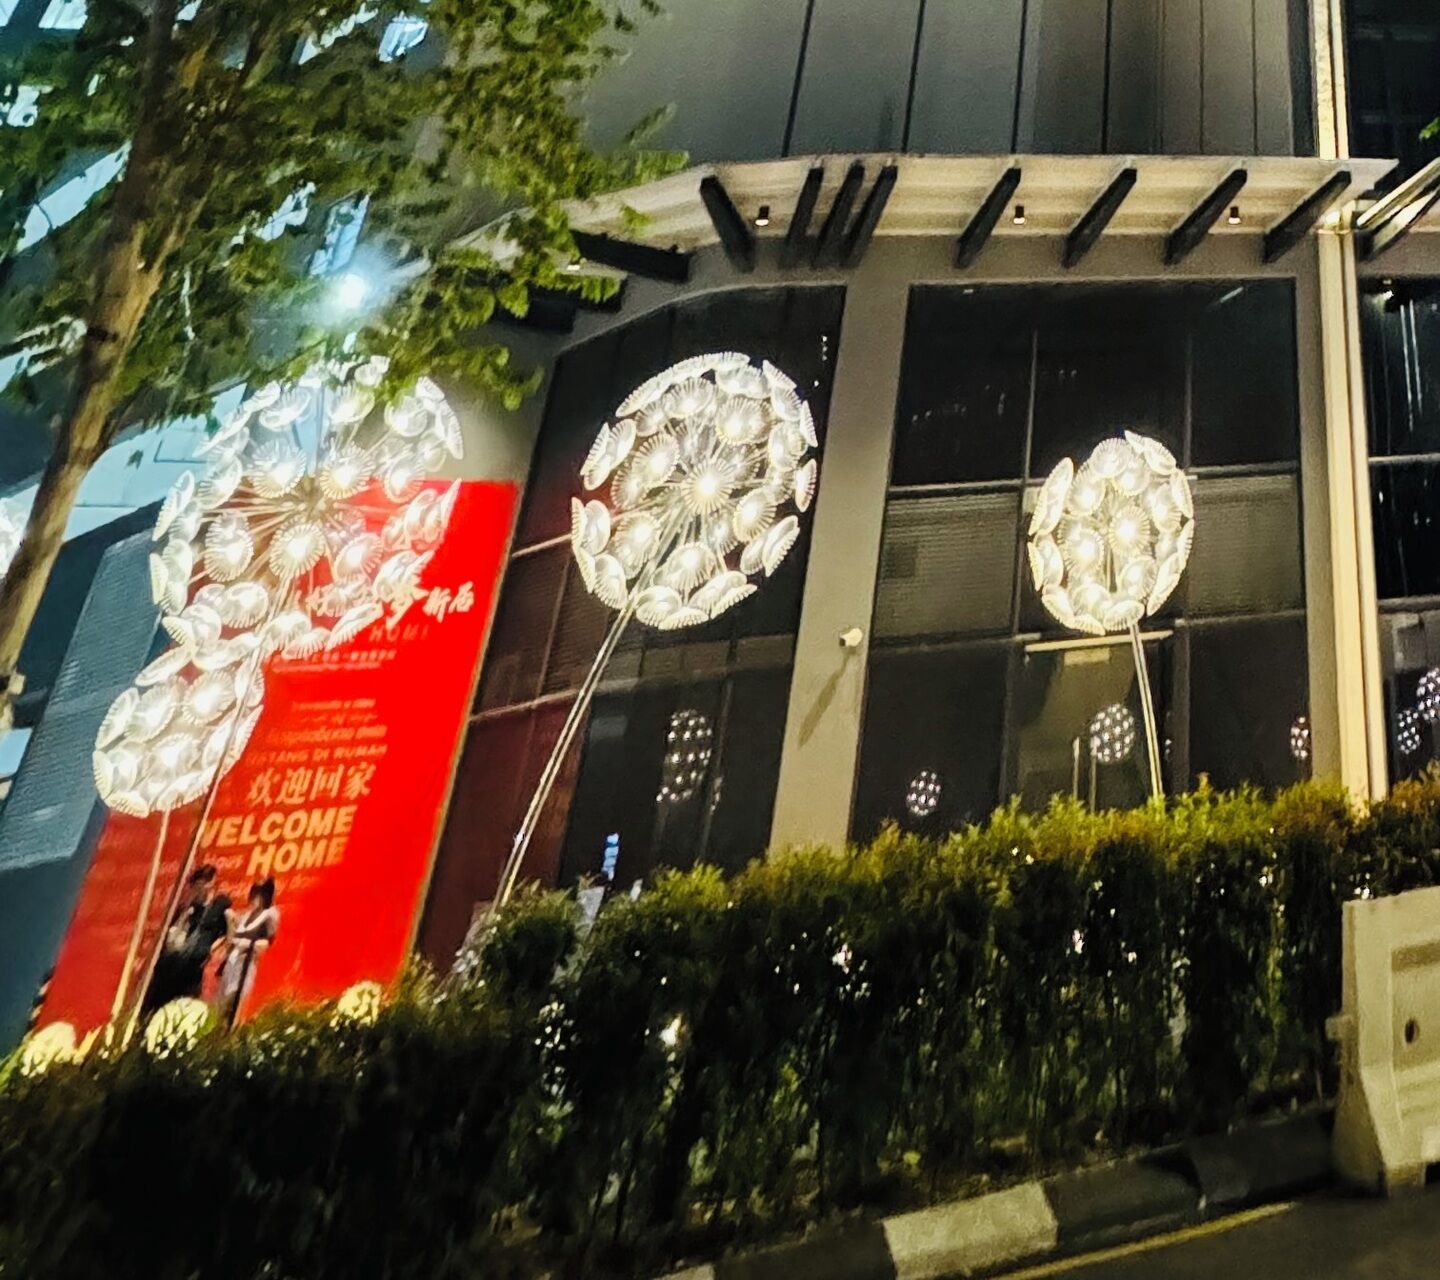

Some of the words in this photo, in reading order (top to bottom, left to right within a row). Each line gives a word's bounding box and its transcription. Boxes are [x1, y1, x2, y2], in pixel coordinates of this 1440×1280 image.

[248, 762, 376, 807] 欢迎回家
[246, 836, 349, 878] HOME
